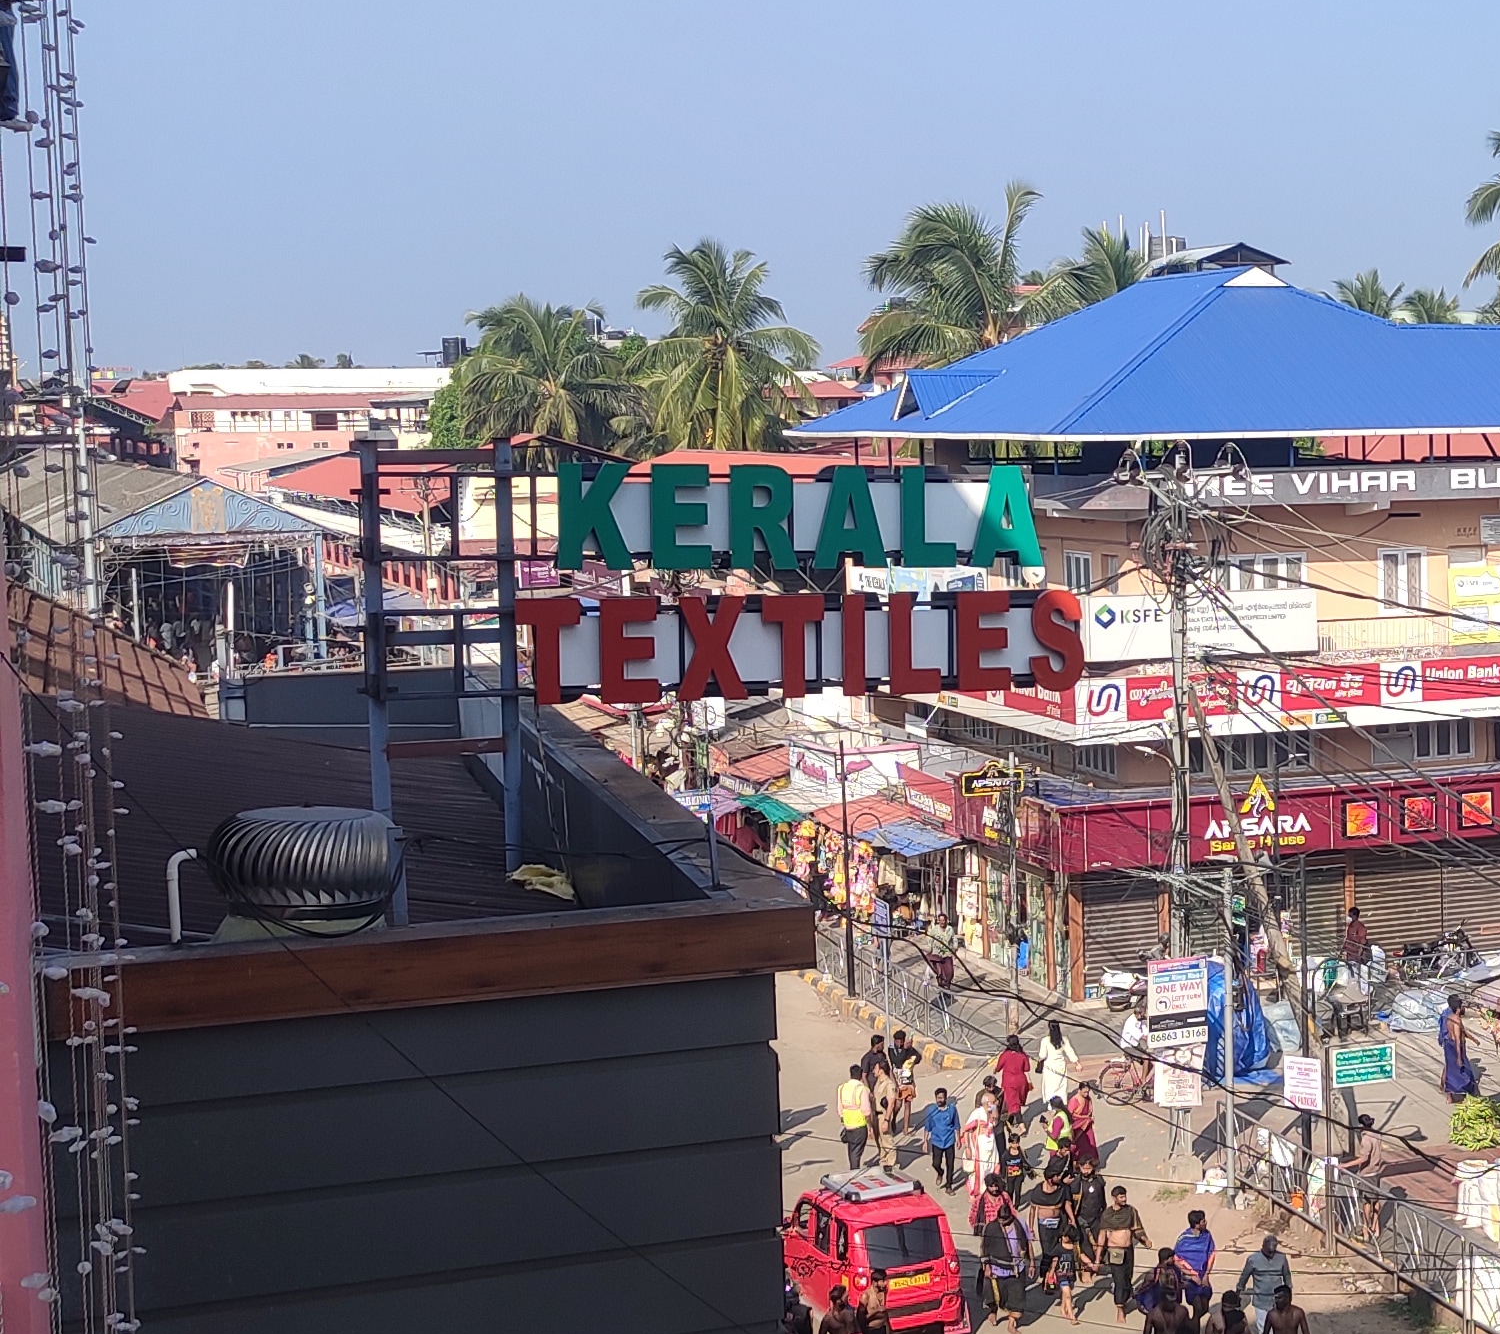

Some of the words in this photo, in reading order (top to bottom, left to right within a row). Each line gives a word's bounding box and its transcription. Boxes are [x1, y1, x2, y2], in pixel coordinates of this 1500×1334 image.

[1292, 470, 1416, 494] VIHAR
[557, 463, 1044, 570] KERALA
[1121, 609, 1163, 623] KSFE
[514, 589, 1084, 704] TEXTILES
[1426, 667, 1463, 681] Union
[1467, 664, 1500, 679] Bank
[1260, 835, 1305, 848] Huse
[1156, 984, 1176, 994] ONE
[1180, 982, 1202, 991] WAY
